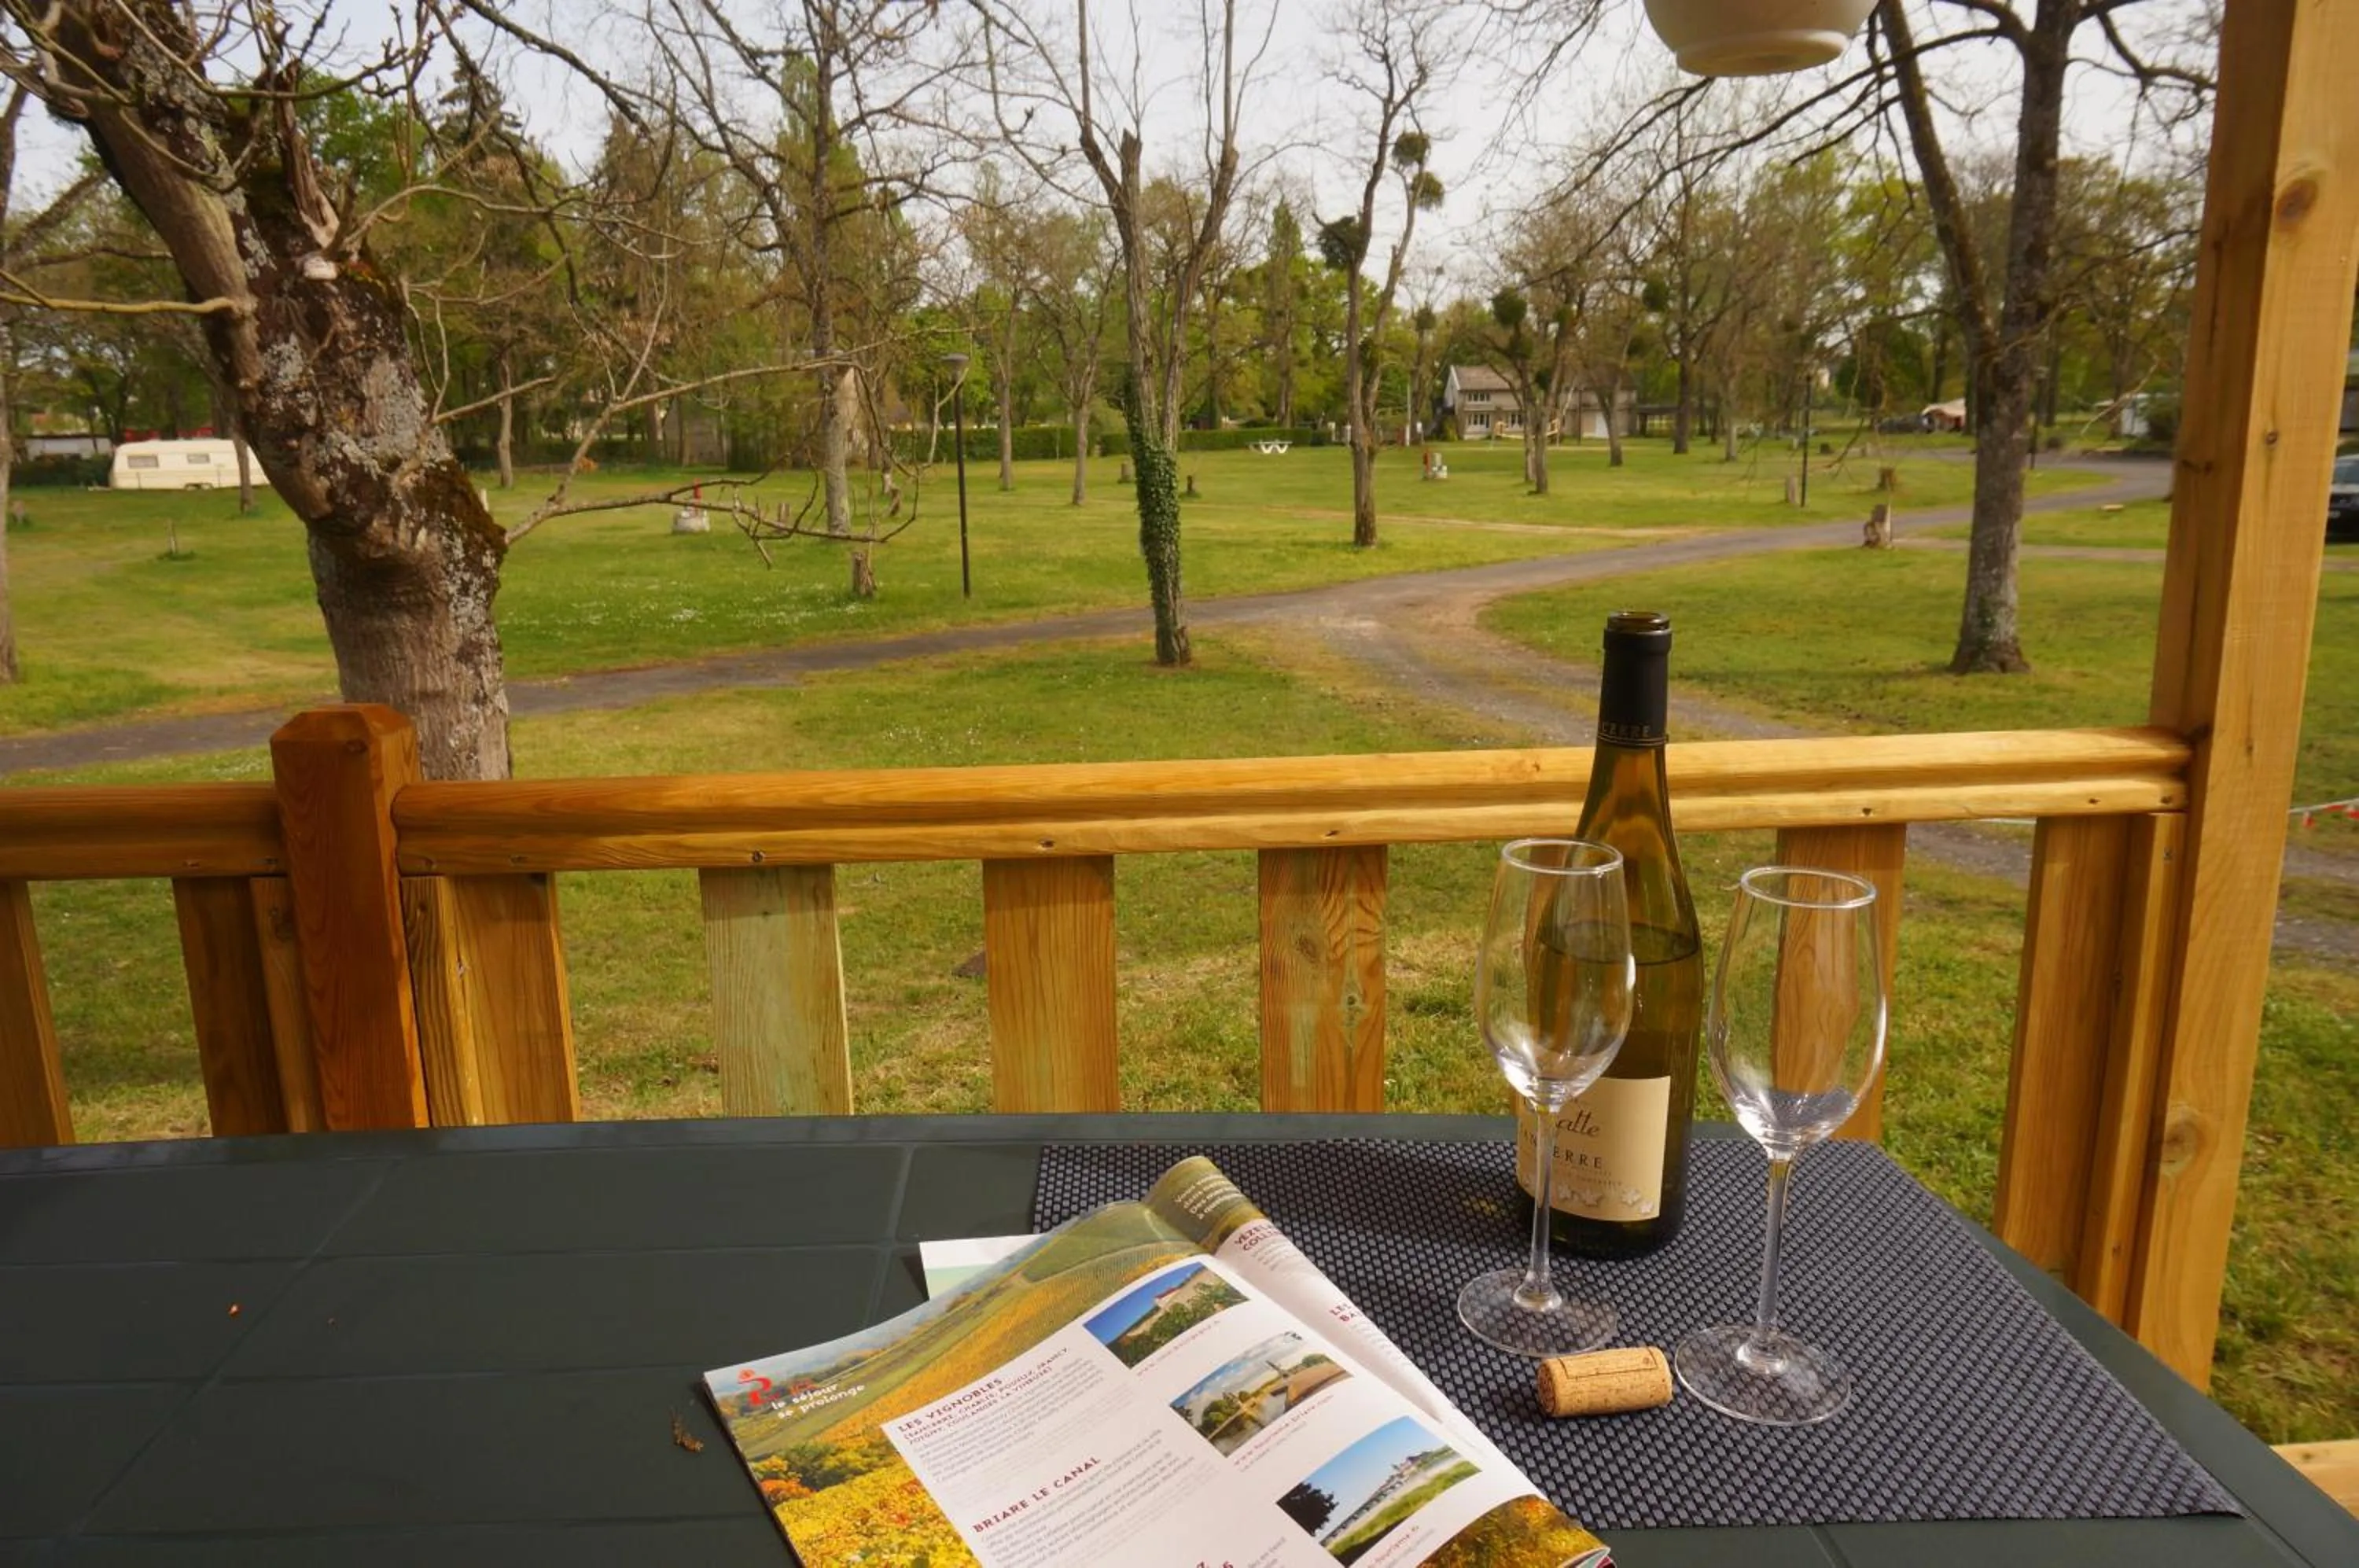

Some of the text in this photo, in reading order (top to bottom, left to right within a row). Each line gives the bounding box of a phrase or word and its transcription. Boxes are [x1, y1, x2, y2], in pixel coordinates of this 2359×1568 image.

[771, 1382, 839, 1411] le séjour
[777, 1383, 866, 1419] se prolonge
[897, 1378, 1003, 1433] LES VIGNOBLES
[971, 1456, 1102, 1533] BRIARE LE CANAL
